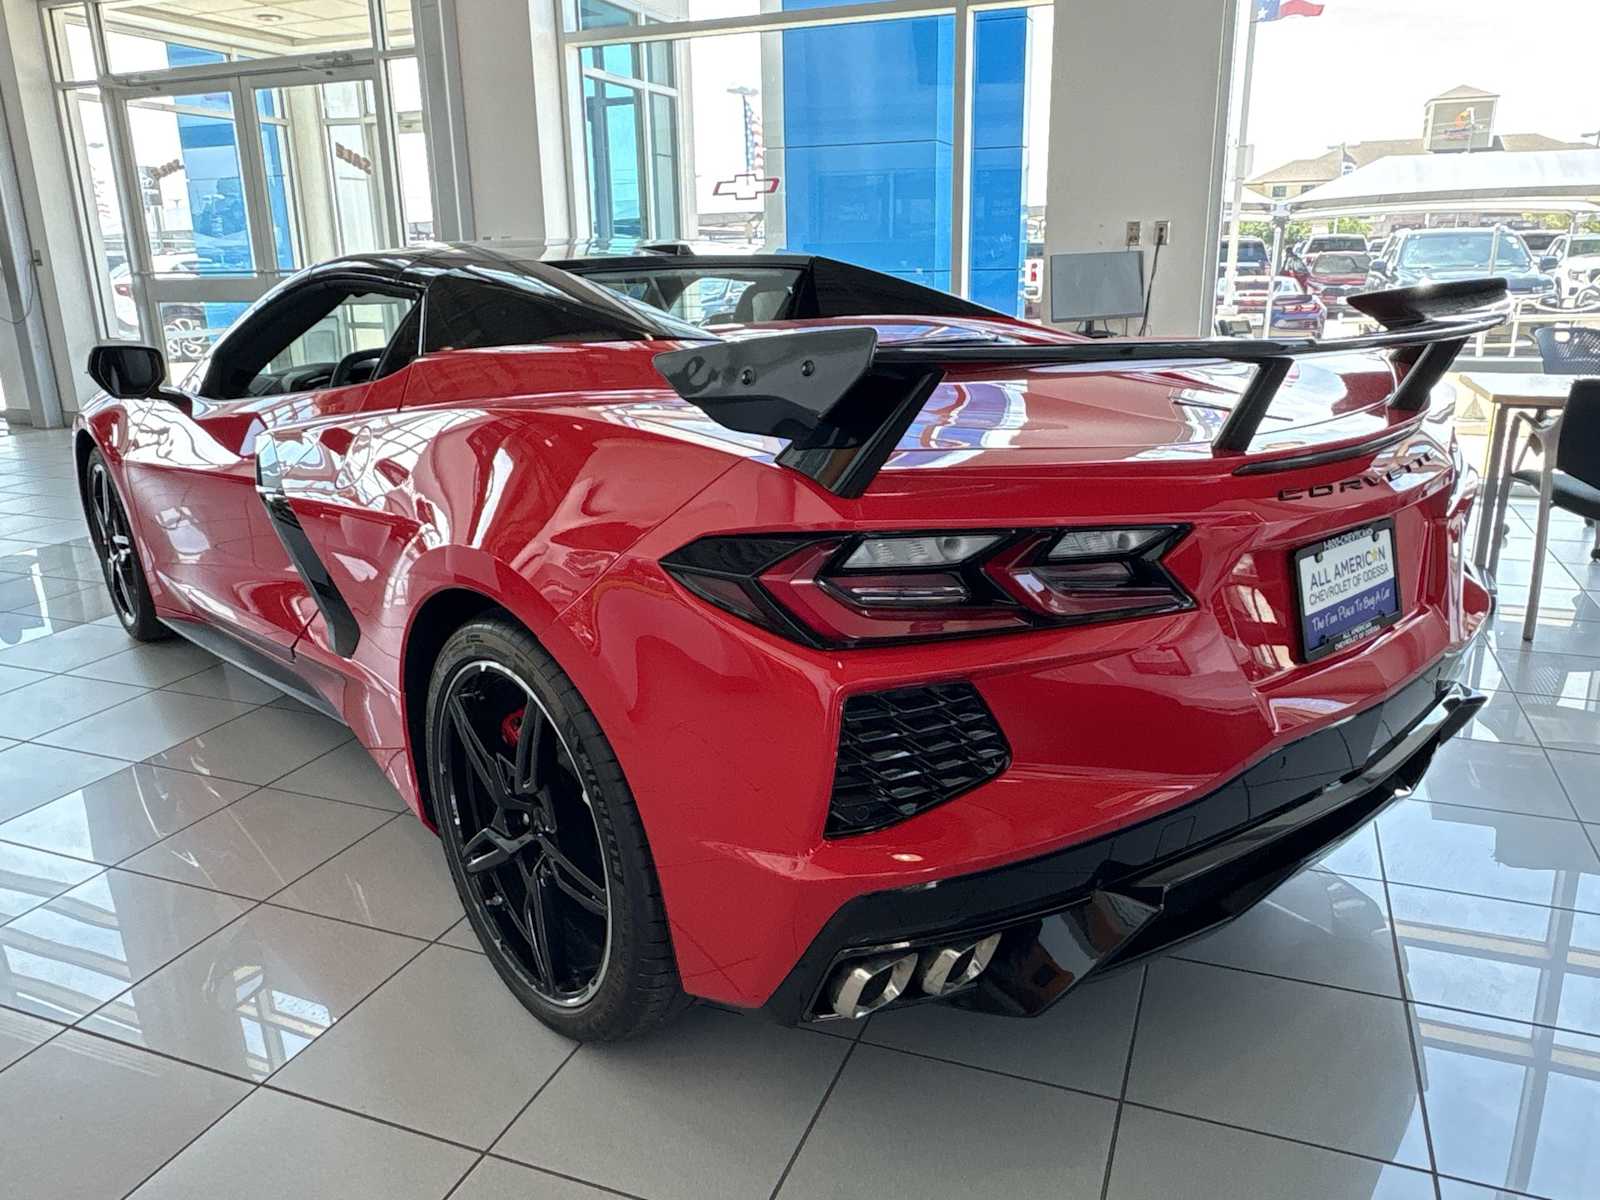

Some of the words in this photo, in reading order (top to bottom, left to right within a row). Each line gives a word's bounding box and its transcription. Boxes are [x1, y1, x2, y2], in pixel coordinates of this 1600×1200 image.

[1309, 580, 1354, 606] CHEVROLET
[1353, 575, 1363, 588] OF
[1363, 564, 1390, 582] ODESSA
[1310, 567, 1332, 591] ALL
